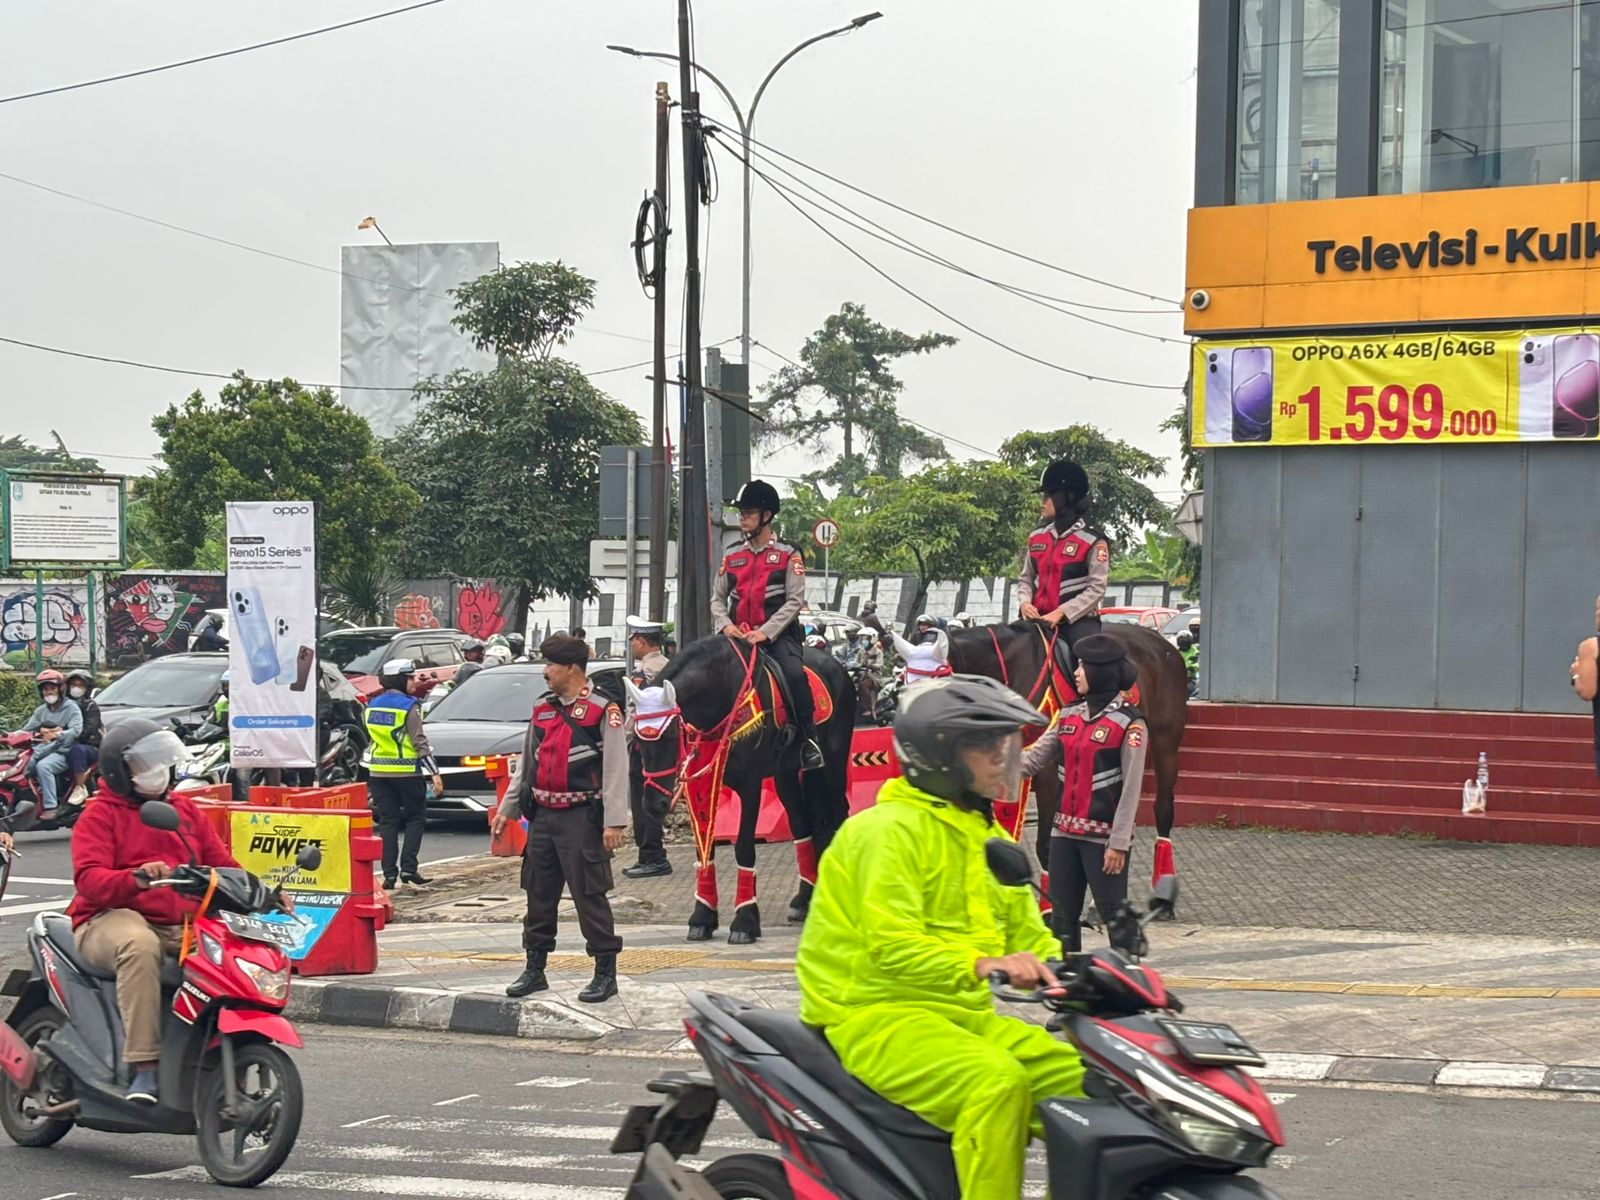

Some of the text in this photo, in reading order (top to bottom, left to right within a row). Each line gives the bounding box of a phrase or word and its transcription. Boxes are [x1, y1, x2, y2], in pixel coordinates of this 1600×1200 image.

[1307, 230, 1477, 274] Televisi
[1292, 337, 1495, 361] OPPO A6X 4GB/64GB
[273, 506, 309, 517] oppo
[229, 547, 266, 558] Reno15
[268, 546, 302, 557] Series
[233, 749, 264, 757] ColorOS
[265, 825, 302, 838] Super
[296, 876, 317, 885] LAMA
[182, 981, 211, 1003] SUZUKI
